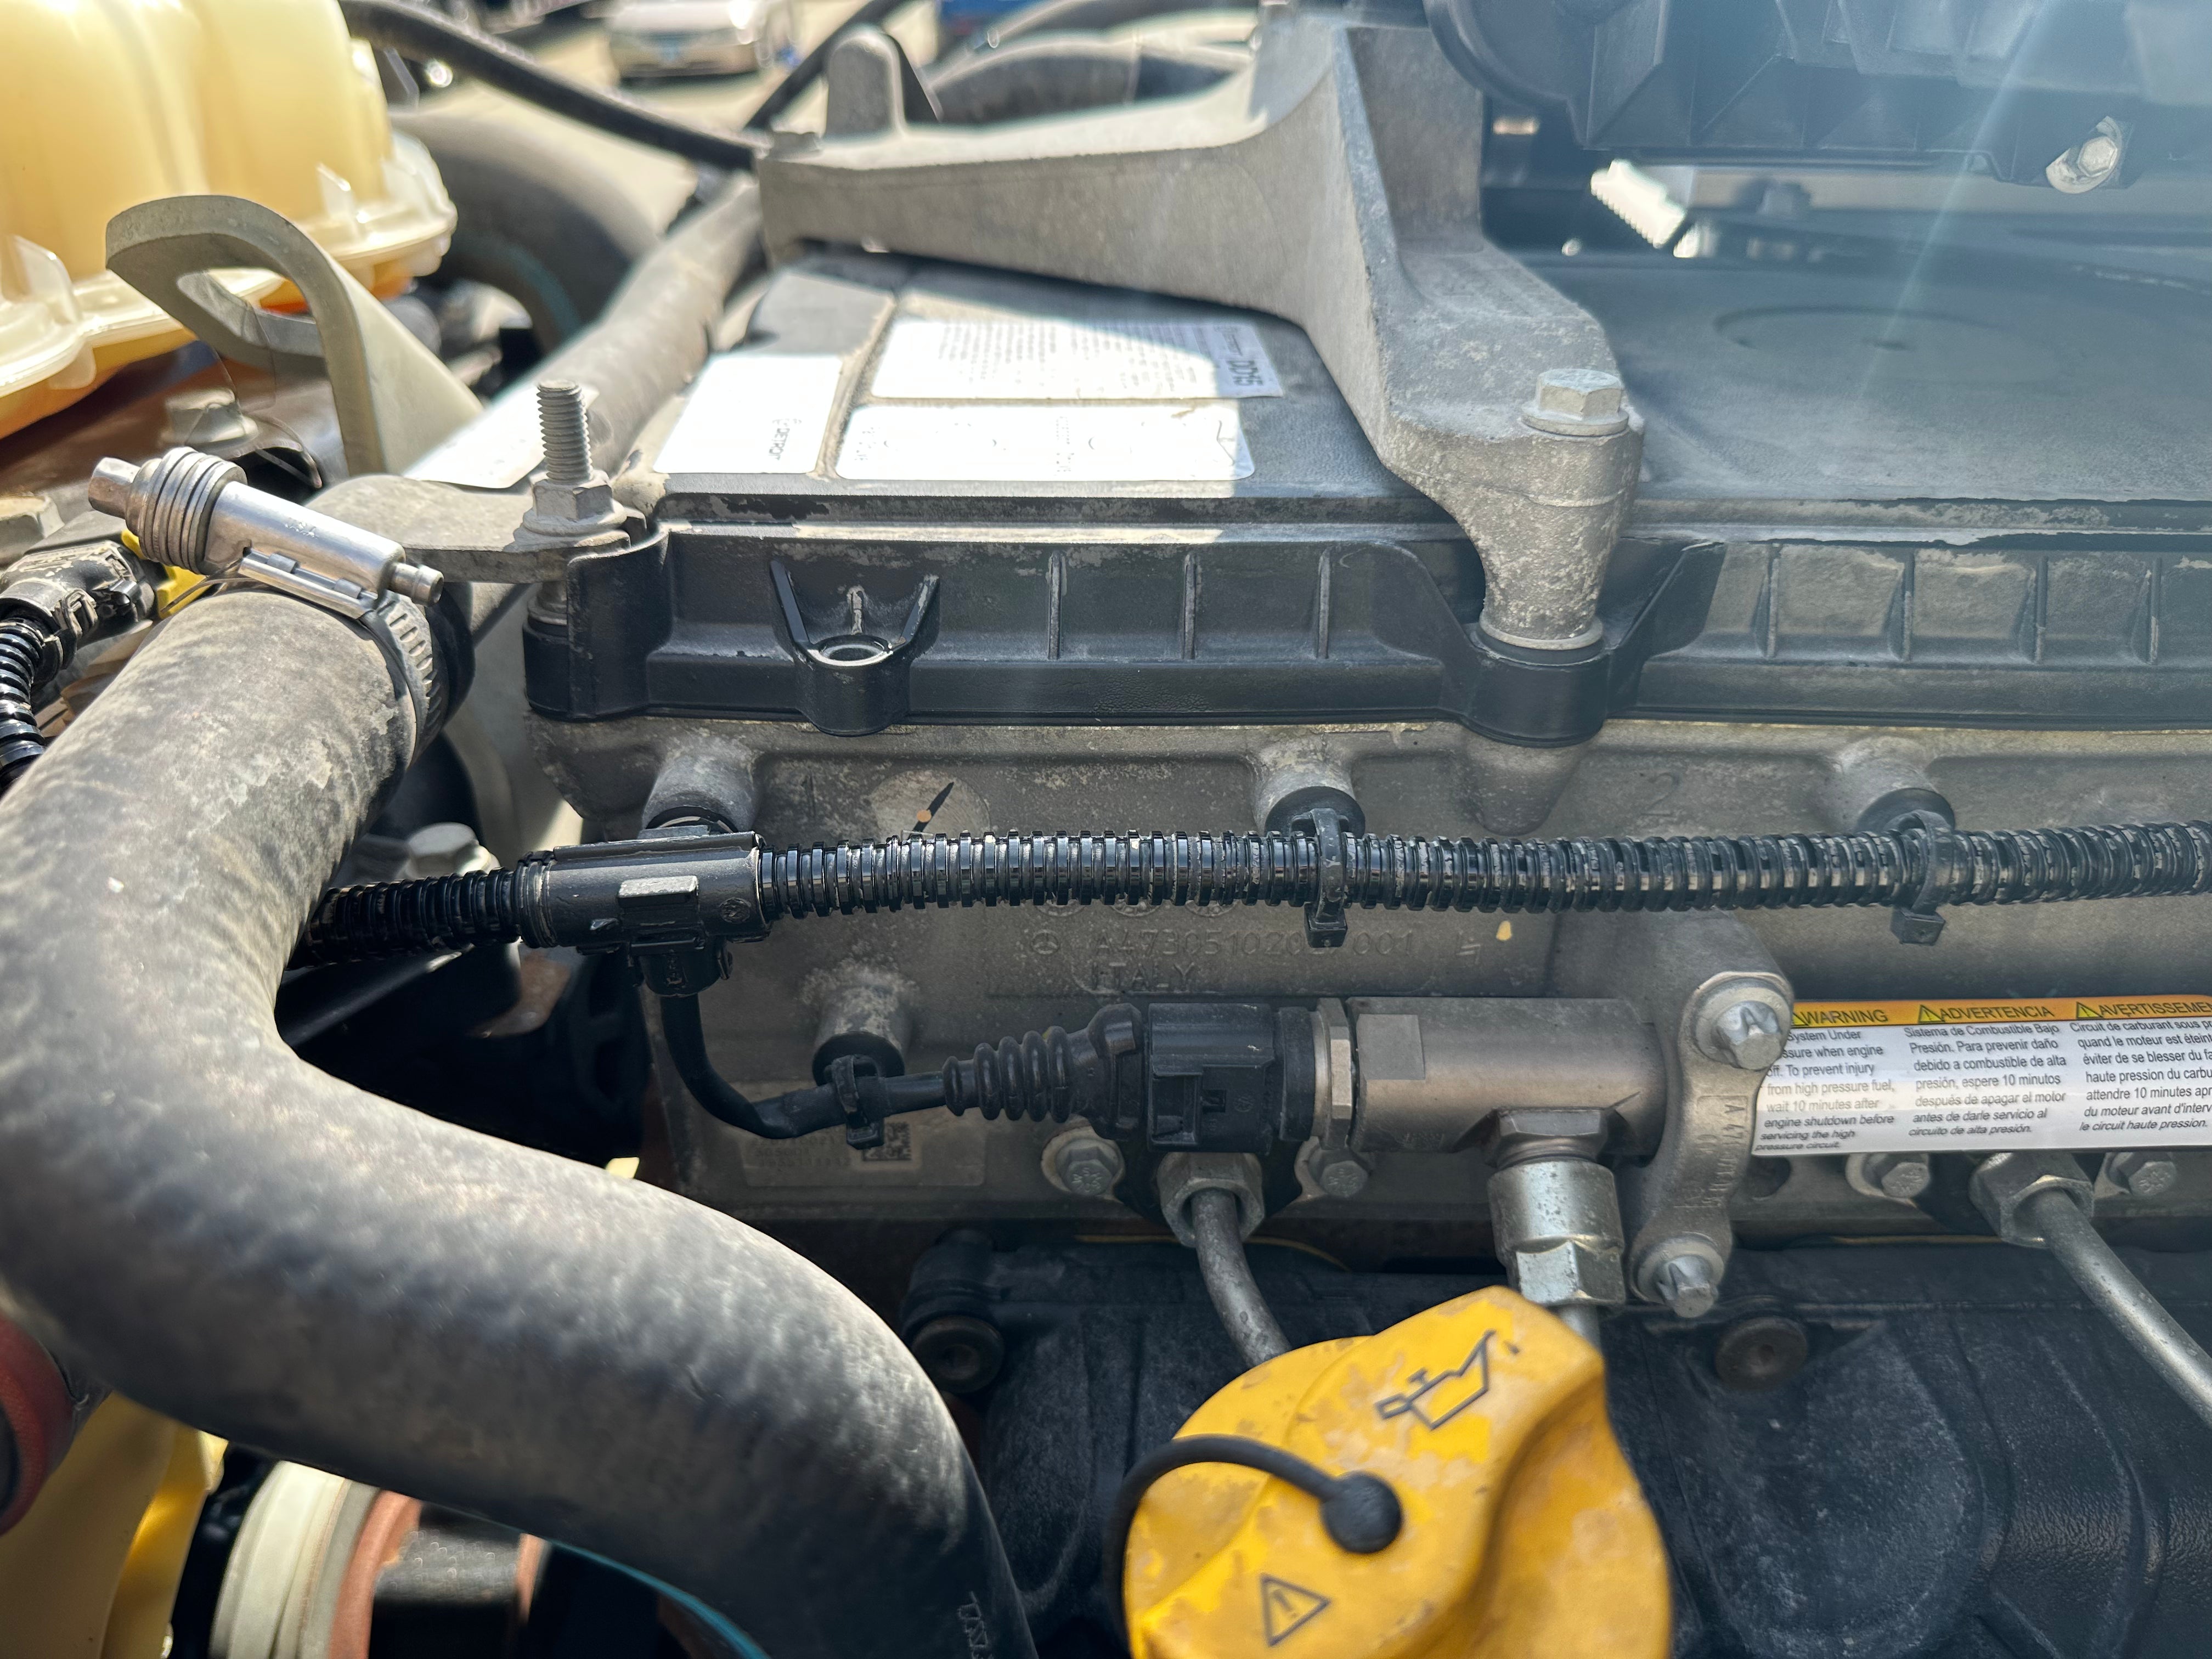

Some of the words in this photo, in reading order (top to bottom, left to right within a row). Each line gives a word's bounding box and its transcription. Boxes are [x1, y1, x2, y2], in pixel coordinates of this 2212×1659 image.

[1801, 1009, 1888, 1024] WARNING
[1939, 1006, 2055, 1019] ADVERTENCIA
[1904, 1027, 1948, 1038] Sistema
[1950, 1026, 1965, 1036] de
[1966, 1024, 2033, 1036] Combustible
[2035, 1023, 2059, 1035] Bajo
[2070, 1023, 2106, 1032] Circuit
[2107, 1022, 2121, 1030] de
[2122, 1020, 2174, 1030] carburant
[1829, 1030, 1861, 1040] Under
[2078, 1036, 2112, 1049] quand
[2112, 1036, 2124, 1046] le
[2125, 1035, 2162, 1046] moteur
[2165, 1034, 2183, 1045] est
[1815, 1046, 1844, 1057] when
[1848, 1045, 1883, 1058] engine
[1956, 1041, 1983, 1052] Para
[1987, 1039, 2028, 1053] prevenir
[2032, 1038, 2059, 1049] daño
[1914, 1059, 1950, 1071] debido
[1953, 1061, 1960, 1070] a
[1963, 1056, 2028, 1069] combustible
[2030, 1055, 2044, 1066] de
[2047, 1055, 2067, 1066] alta
[2083, 1052, 2112, 1065] éviter
[2115, 1052, 2129, 1063] de
[2131, 1053, 2145, 1063] se
[2146, 1051, 2186, 1062] blesser
[2188, 1049, 2202, 1060] du
[1785, 1064, 1799, 1076] To
[1802, 1065, 1843, 1078] prevent
[1845, 1062, 1875, 1076] injury
[2085, 1071, 2116, 1083] haute
[2119, 1069, 2164, 1084] pression
[2167, 1068, 2180, 1079] du
[1768, 1084, 1791, 1095] from
[1795, 1082, 1818, 1096] high
[1821, 1081, 1869, 1095] pressure
[1871, 1079, 1895, 1093] fuel,
[1962, 1076, 1999, 1089] espere
[2002, 1074, 2016, 1086] 10
[2019, 1073, 2061, 1085] minutos
[1915, 1094, 1962, 1108] después
[1964, 1095, 1978, 1105] de
[1981, 1093, 2019, 1107] apagar
[2022, 1092, 2032, 1103] el
[2035, 1092, 2066, 1102] motor
[2086, 1088, 2131, 1101] attendre
[2134, 1087, 2147, 1098] 10
[2150, 1086, 2192, 1098] minutes
[1767, 1102, 1789, 1112] wait
[1793, 1101, 1805, 1111] 10
[1809, 1099, 1851, 1110] minutes
[1854, 1098, 1880, 1109] after
[2084, 1106, 2098, 1117] du
[2100, 1105, 2140, 1116] moteur
[2141, 1103, 2171, 1114] avant
[1764, 1117, 1801, 1128] engine
[1804, 1115, 1857, 1126] shutdown
[1859, 1114, 1894, 1124] before
[1912, 1113, 1943, 1122] antes
[1945, 1111, 1960, 1121] de
[1962, 1110, 1990, 1121] darle
[1993, 1109, 2034, 1120] servicio
[2037, 1108, 2048, 1118] al
[1909, 1127, 1948, 1136] circuito
[1950, 1126, 1965, 1135] de
[1967, 1125, 1987, 1134] alta
[2079, 1121, 2090, 1131] le
[2092, 1120, 2125, 1130] circuit
[2126, 1120, 2158, 1130] haute
[2158, 1118, 2208, 1131] pression.
[1760, 1131, 1809, 1141] servicing
[1812, 1130, 1829, 1138] the
[1832, 1129, 1856, 1139] high
[1755, 1143, 1804, 1151] pressure
